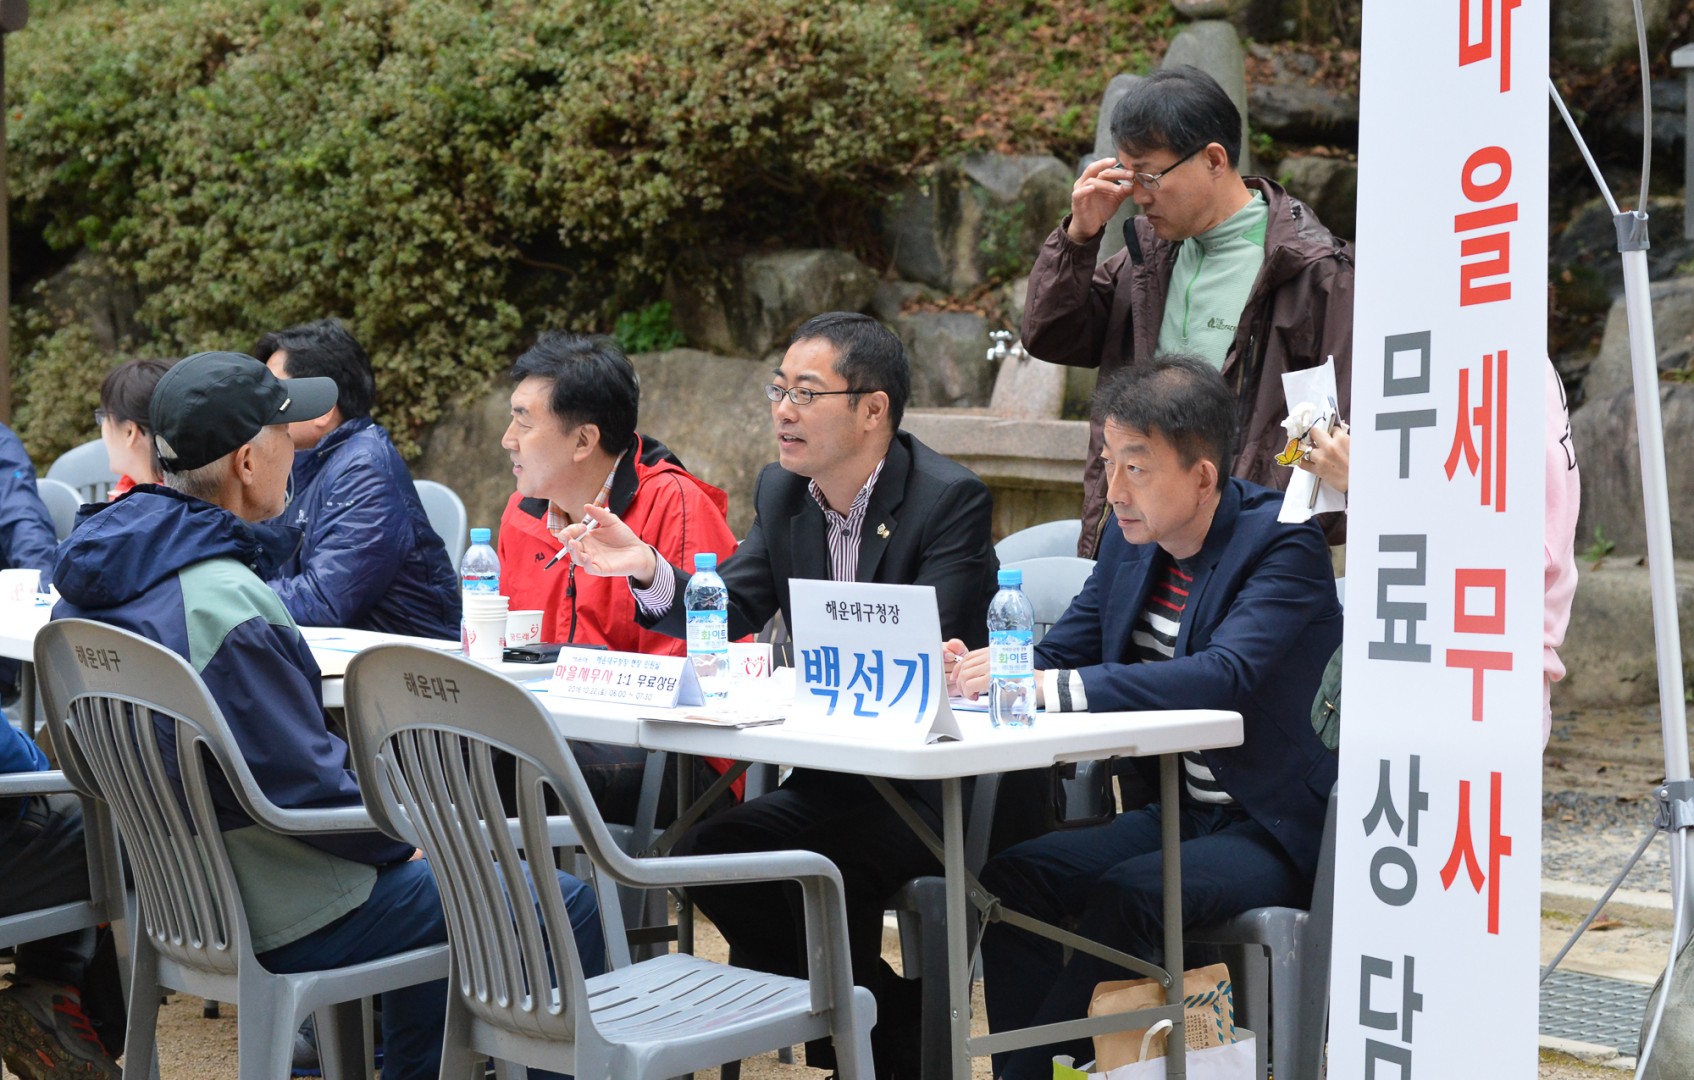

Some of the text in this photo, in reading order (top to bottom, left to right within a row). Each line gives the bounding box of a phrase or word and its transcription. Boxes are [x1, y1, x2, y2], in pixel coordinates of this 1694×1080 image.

[825, 600, 900, 624] 해운대구청장
[701, 629, 727, 640] 화이트
[75, 645, 121, 673] 해운대구
[998, 652, 1029, 664] 화이트
[555, 664, 614, 685] 마을세무사
[616, 673, 632, 686] 1:1
[801, 646, 930, 723] 백선기
[403, 672, 460, 704] 해운대구
